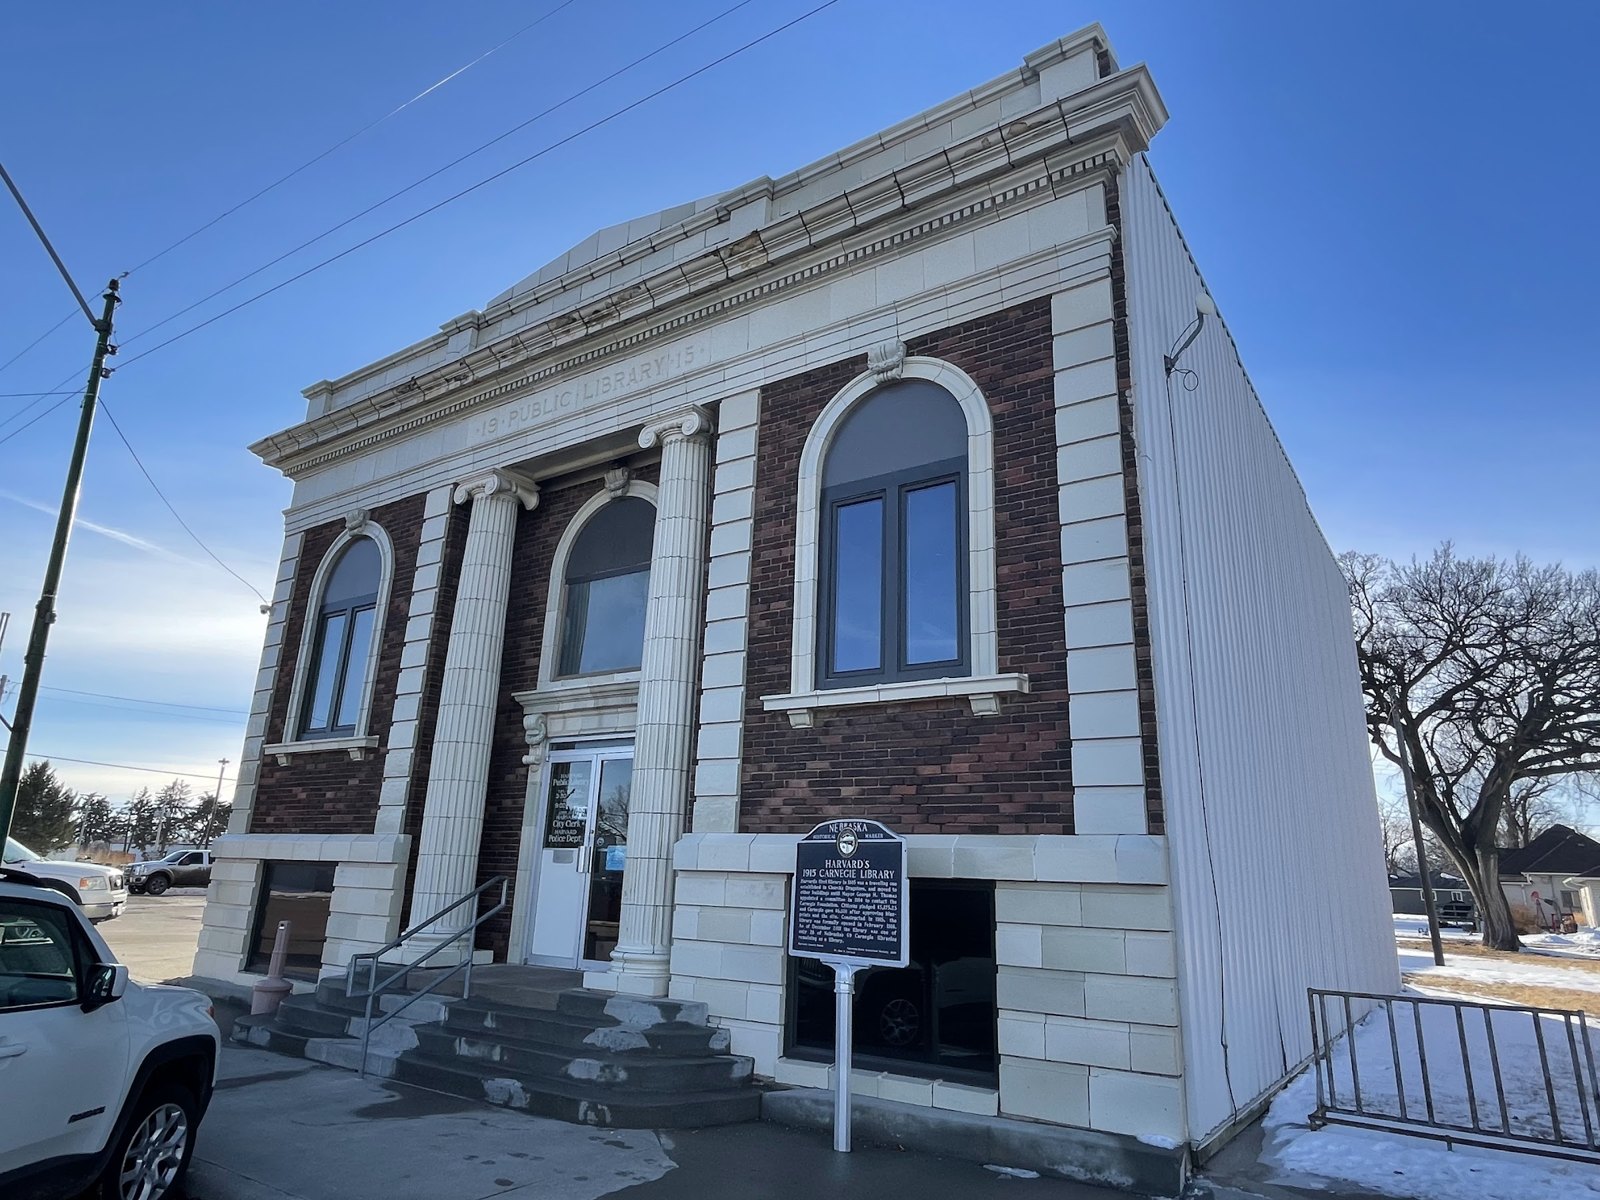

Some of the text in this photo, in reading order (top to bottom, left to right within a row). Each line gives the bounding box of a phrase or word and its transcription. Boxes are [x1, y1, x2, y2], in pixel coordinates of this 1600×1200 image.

[508, 391, 573, 428] PUBLIC
[583, 358, 665, 399] LIBRARY
[552, 820, 564, 828] City
[548, 834, 566, 842] Police
[825, 860, 870, 868] HARVARD'S
[802, 869, 894, 879] 1915 CARNEGIE LIBRARY
